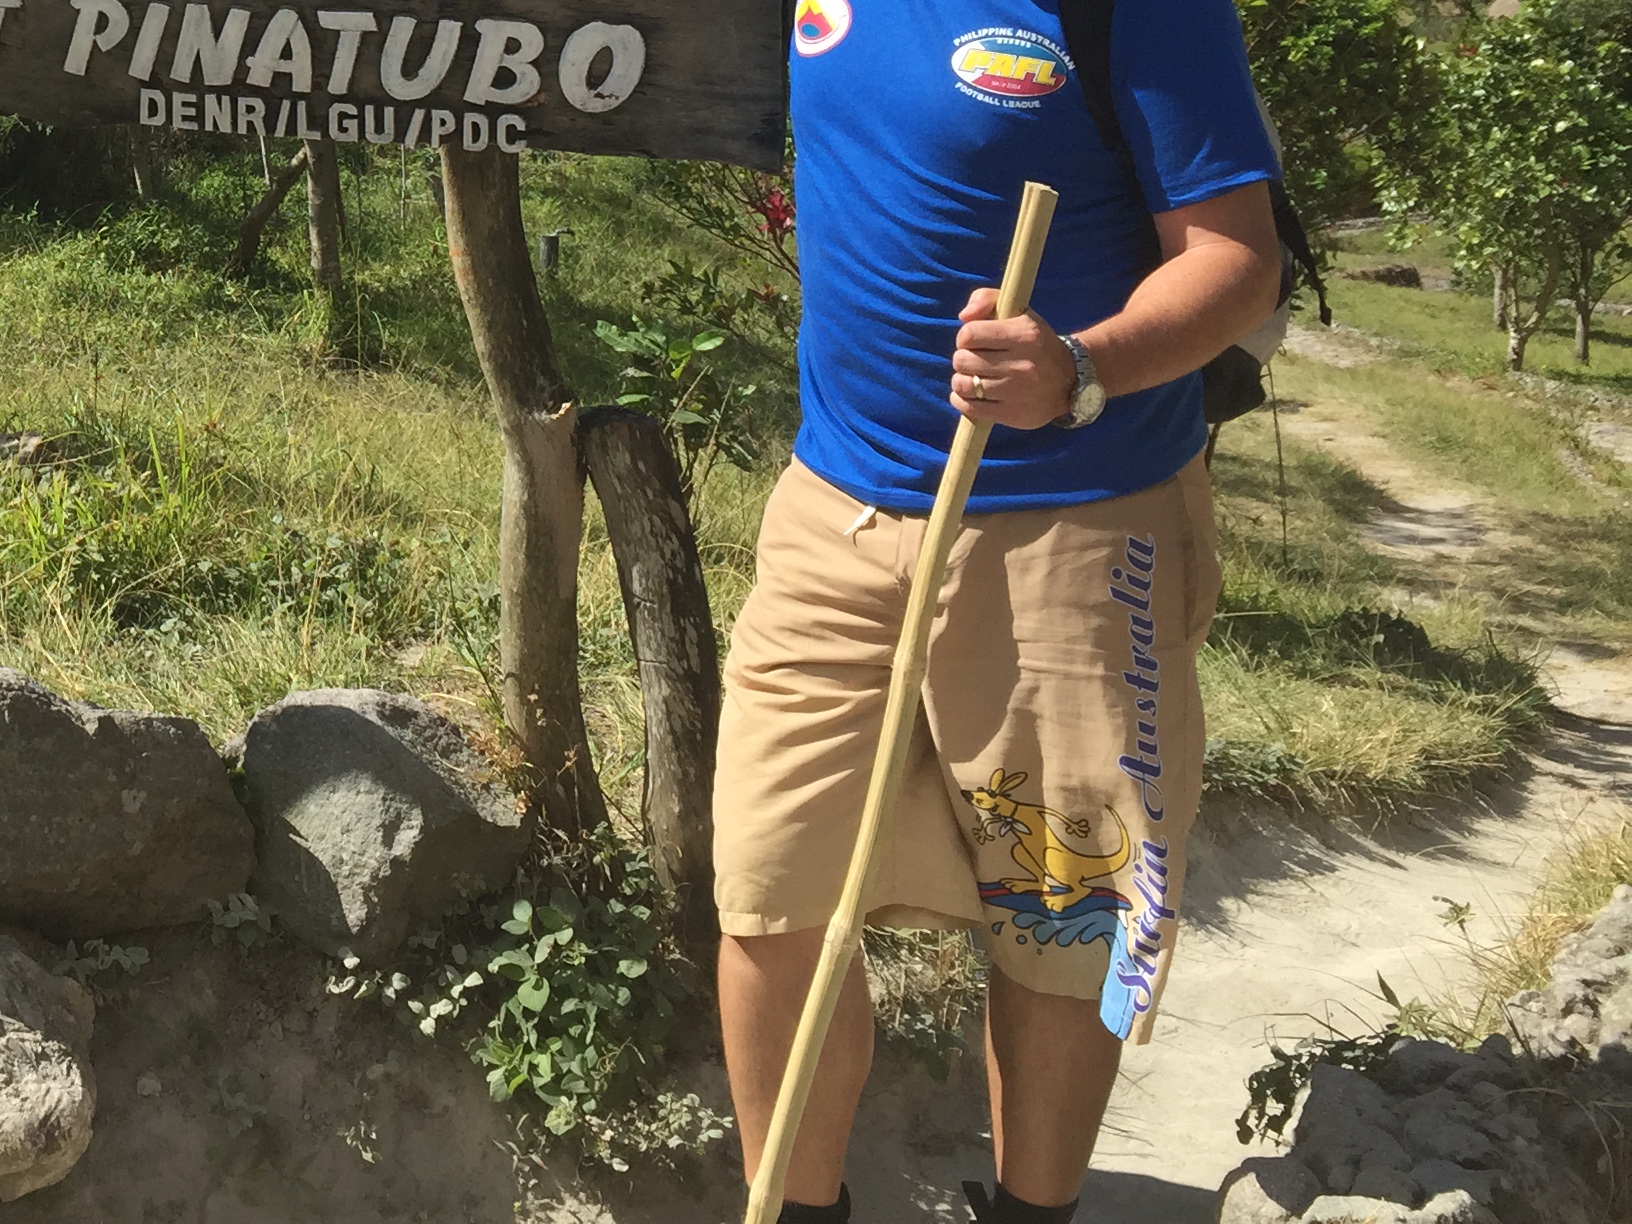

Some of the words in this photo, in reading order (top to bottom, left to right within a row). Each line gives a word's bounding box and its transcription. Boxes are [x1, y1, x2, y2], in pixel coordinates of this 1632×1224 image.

[953, 27, 1013, 47] PHILIPPINE
[1015, 29, 1076, 70] AUSTRALIAN
[958, 48, 1056, 87] PAFL
[954, 81, 1000, 106] FOOTBALL
[1002, 99, 1041, 109] LEAGUE
[138, 86, 528, 154] DENR/LGU/PDC
[1107, 533, 1166, 823] Australia
